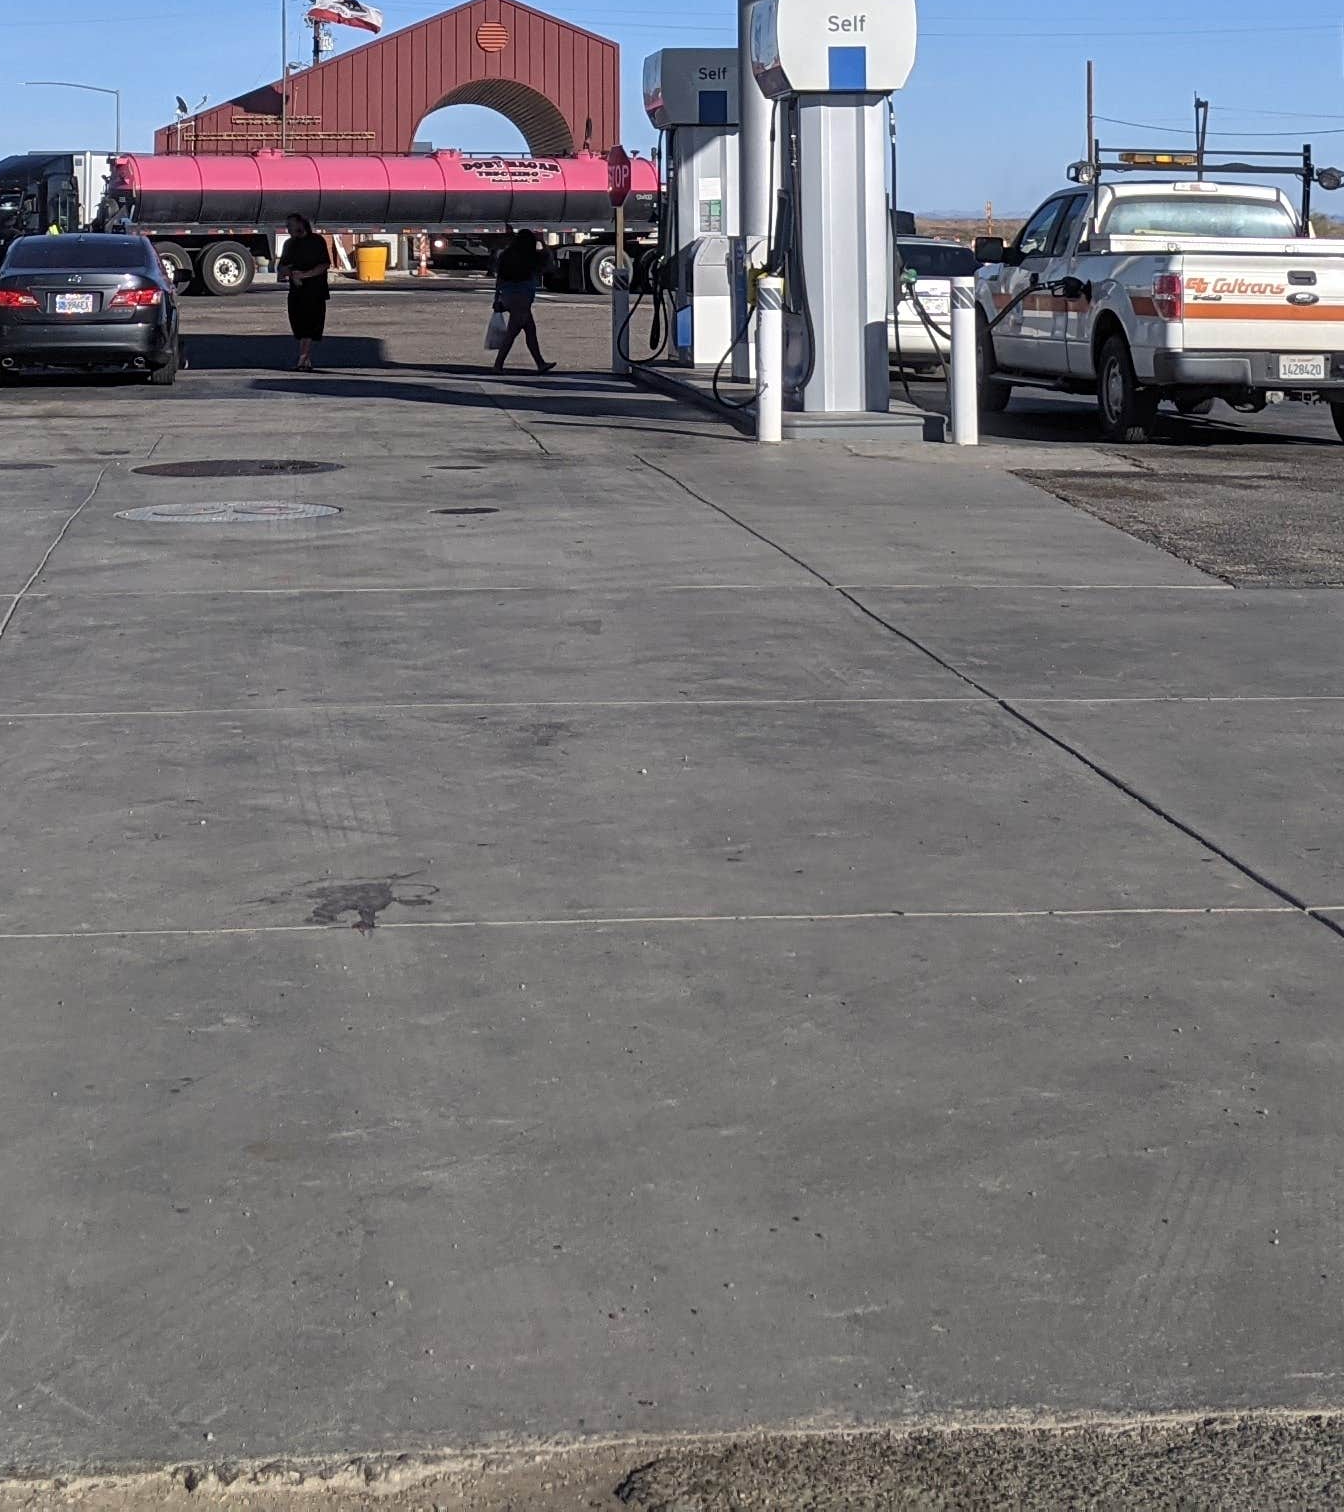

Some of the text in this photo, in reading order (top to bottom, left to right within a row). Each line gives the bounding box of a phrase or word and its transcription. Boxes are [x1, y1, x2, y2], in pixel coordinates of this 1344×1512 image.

[827, 14, 867, 32] Self
[698, 67, 728, 80] Self
[1212, 277, 1286, 295] Caltrans
[1282, 363, 1322, 377] 1428420
